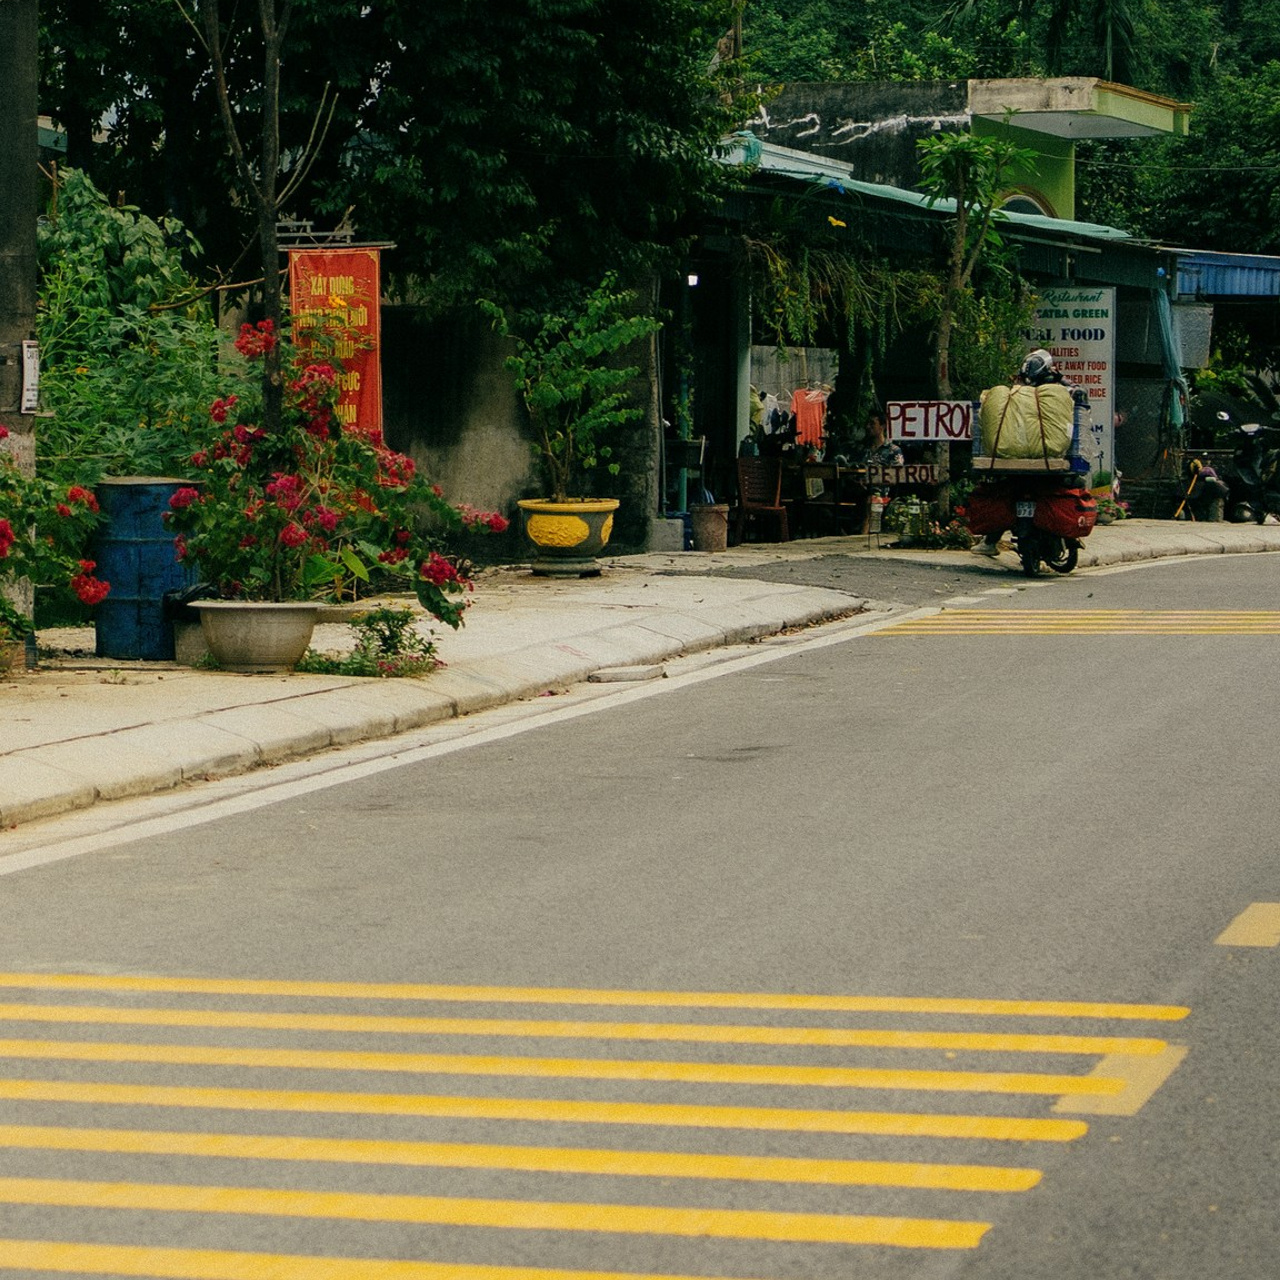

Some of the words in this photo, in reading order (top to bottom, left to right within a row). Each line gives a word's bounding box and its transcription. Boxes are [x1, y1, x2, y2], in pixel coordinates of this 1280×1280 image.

[1042, 289, 1105, 307] Restaurant
[1073, 308, 1109, 318] GREEN
[1061, 328, 1105, 341] FOOD
[1065, 361, 1086, 371] AWAY
[1088, 361, 1107, 371] FOOD
[1085, 375, 1102, 385] RICE
[1089, 388, 1106, 398] RICE
[887, 402, 971, 439] PETROL
[868, 465, 938, 484] PETROL
